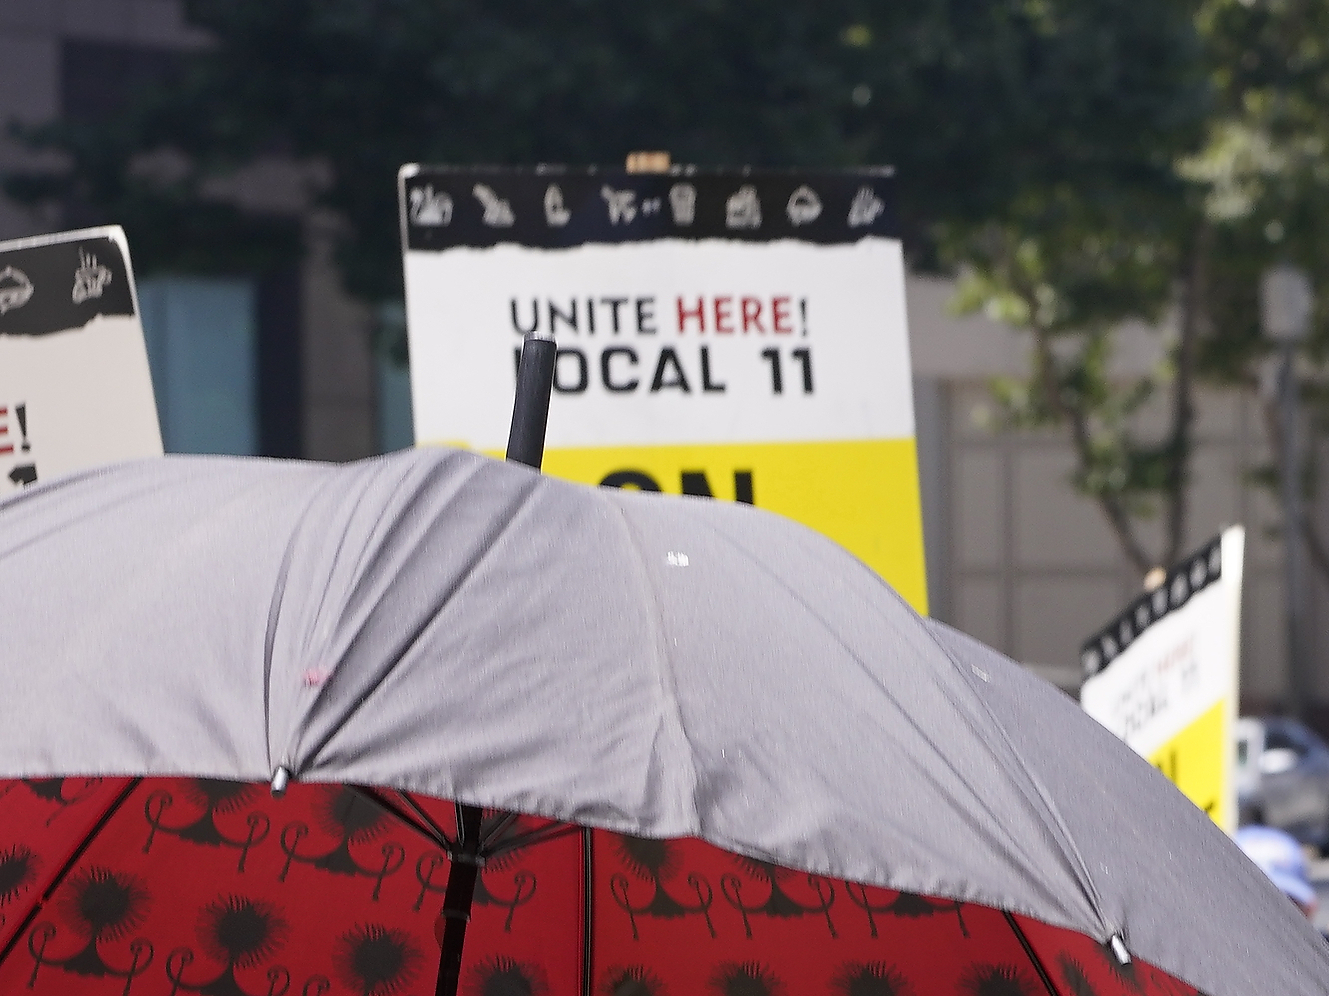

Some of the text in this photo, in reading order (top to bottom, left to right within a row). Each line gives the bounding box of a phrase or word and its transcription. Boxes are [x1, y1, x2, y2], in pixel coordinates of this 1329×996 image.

[510, 296, 809, 337] UNITE HERE!
[513, 344, 815, 396] OCAL 11
